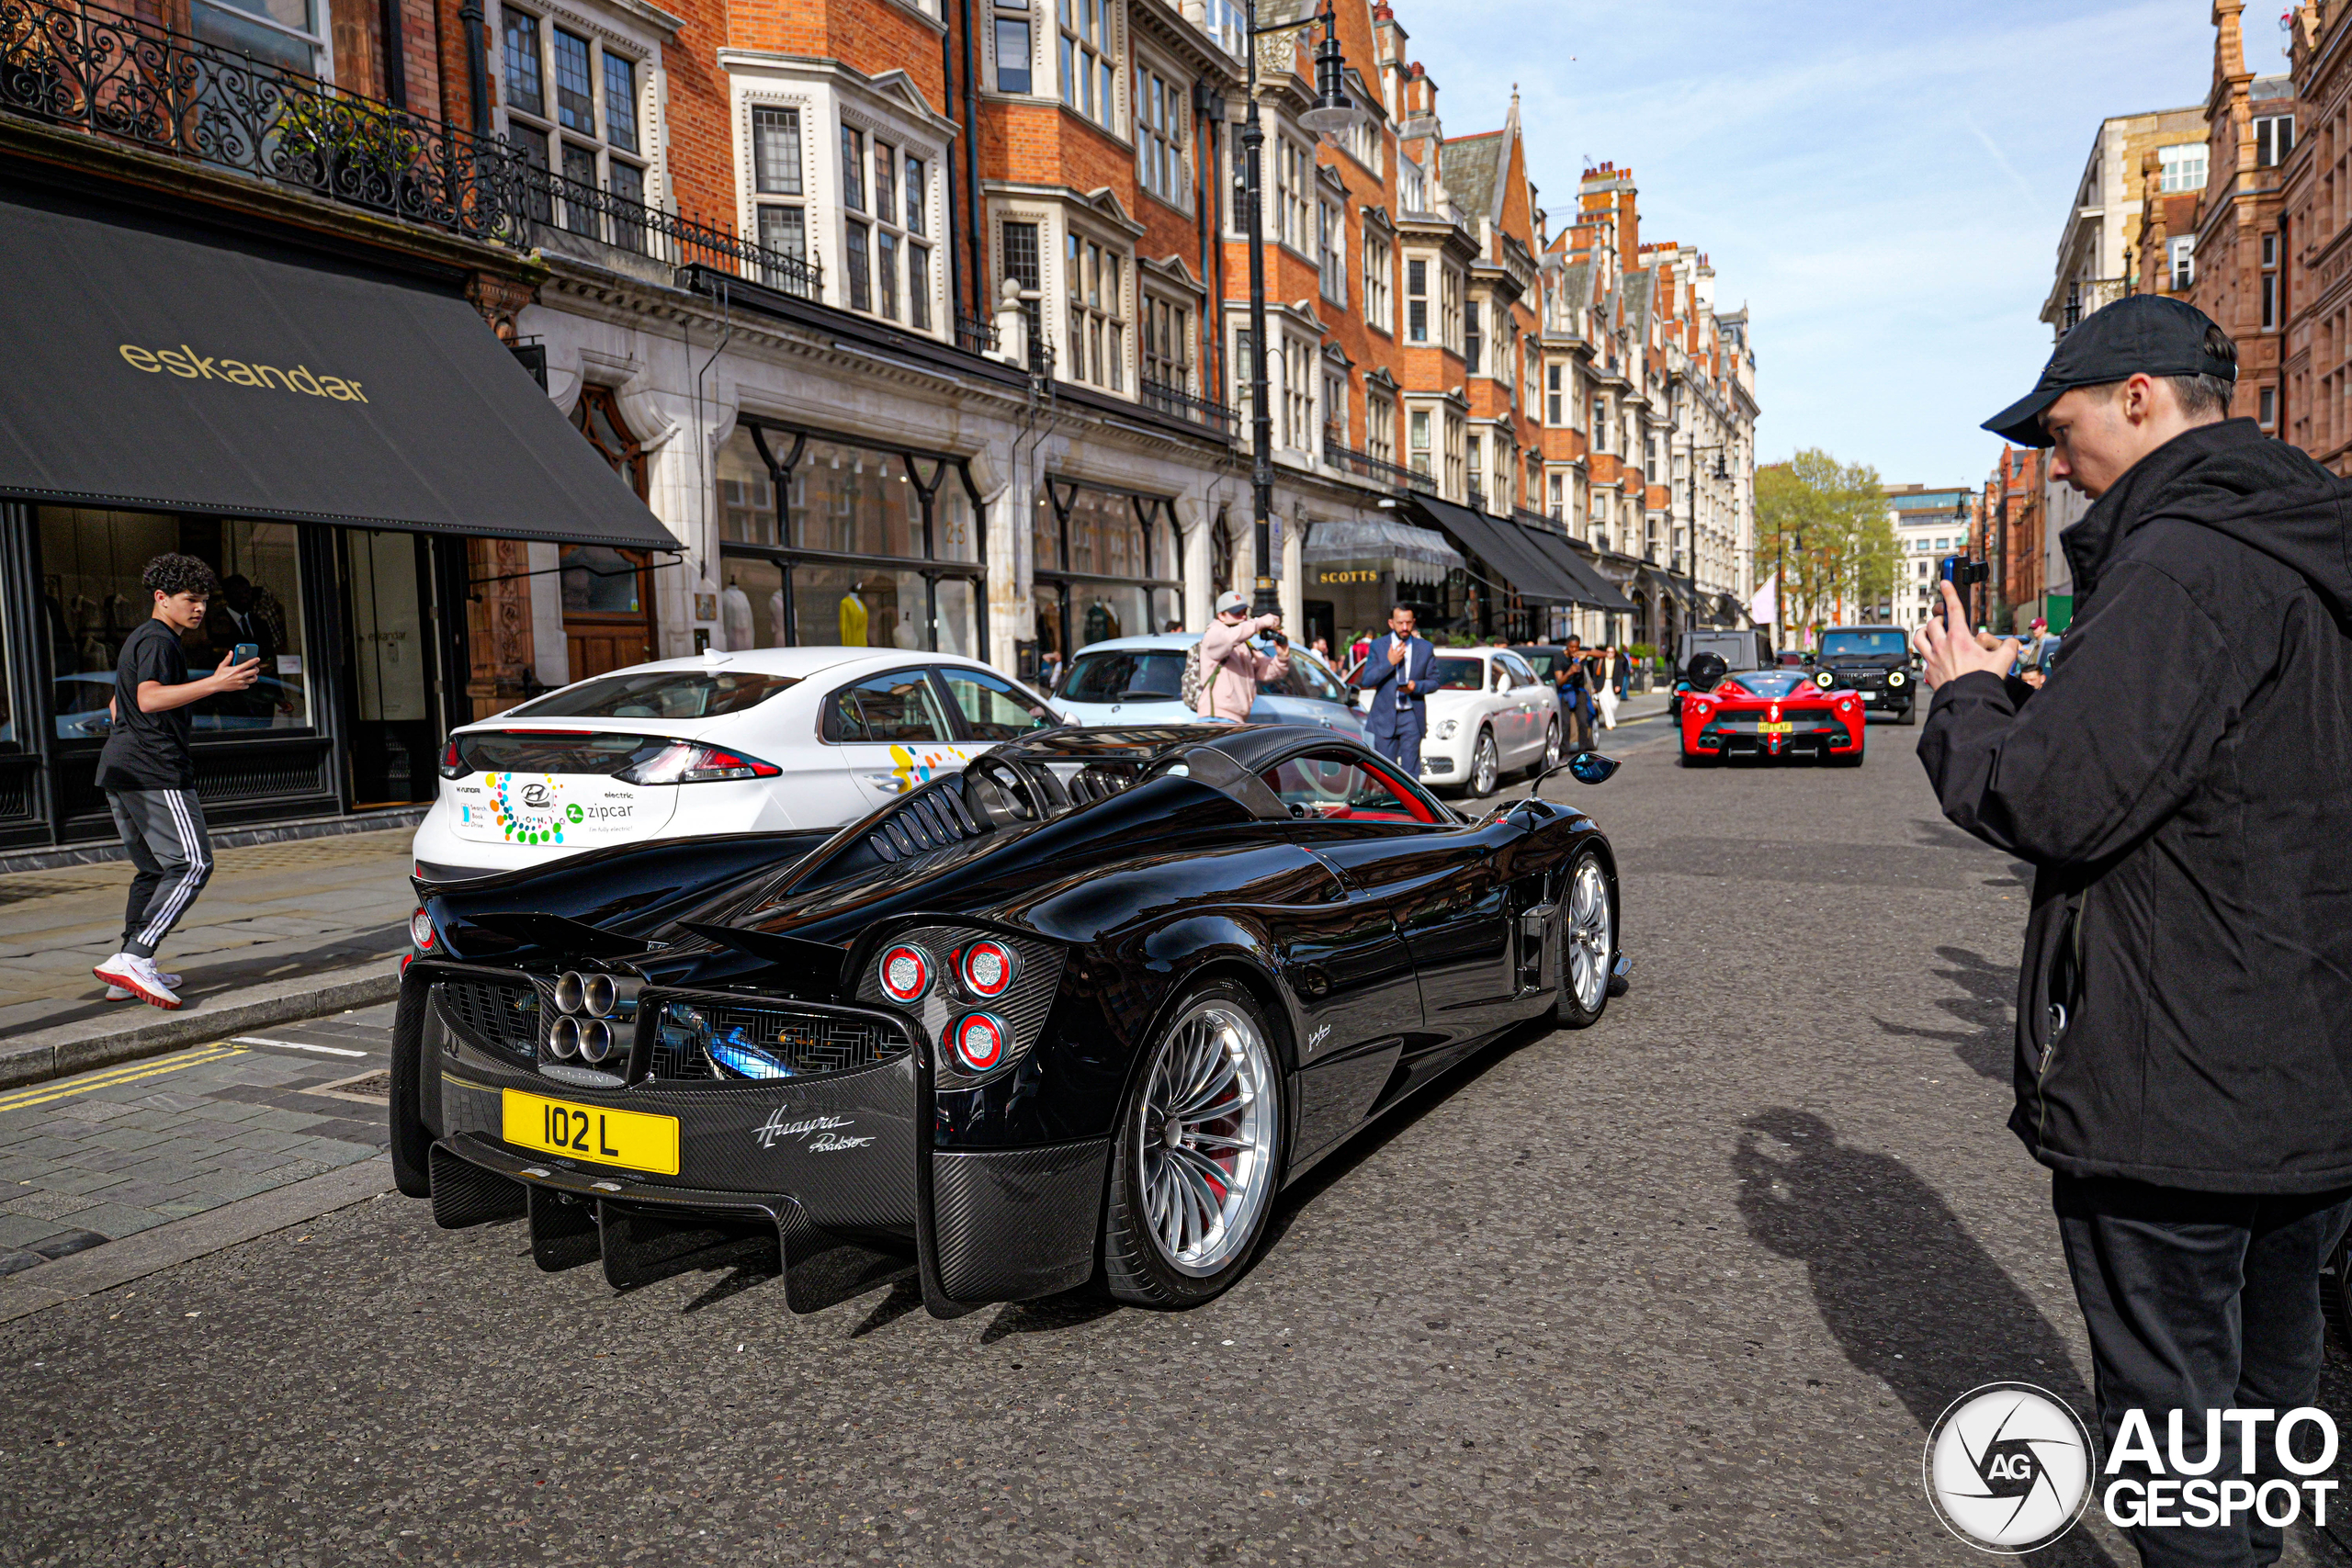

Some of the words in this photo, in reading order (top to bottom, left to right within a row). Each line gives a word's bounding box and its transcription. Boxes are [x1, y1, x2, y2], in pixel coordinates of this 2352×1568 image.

[119, 344, 369, 403] eskandar
[945, 522, 966, 545] 25
[1320, 570, 1377, 583] SCOTTS
[368, 631, 406, 641] ekandar
[587, 803, 633, 821] zipcar
[599, 1114, 619, 1157] L
[750, 1103, 855, 1150] Huayra
[808, 1132, 877, 1154] Roadster
